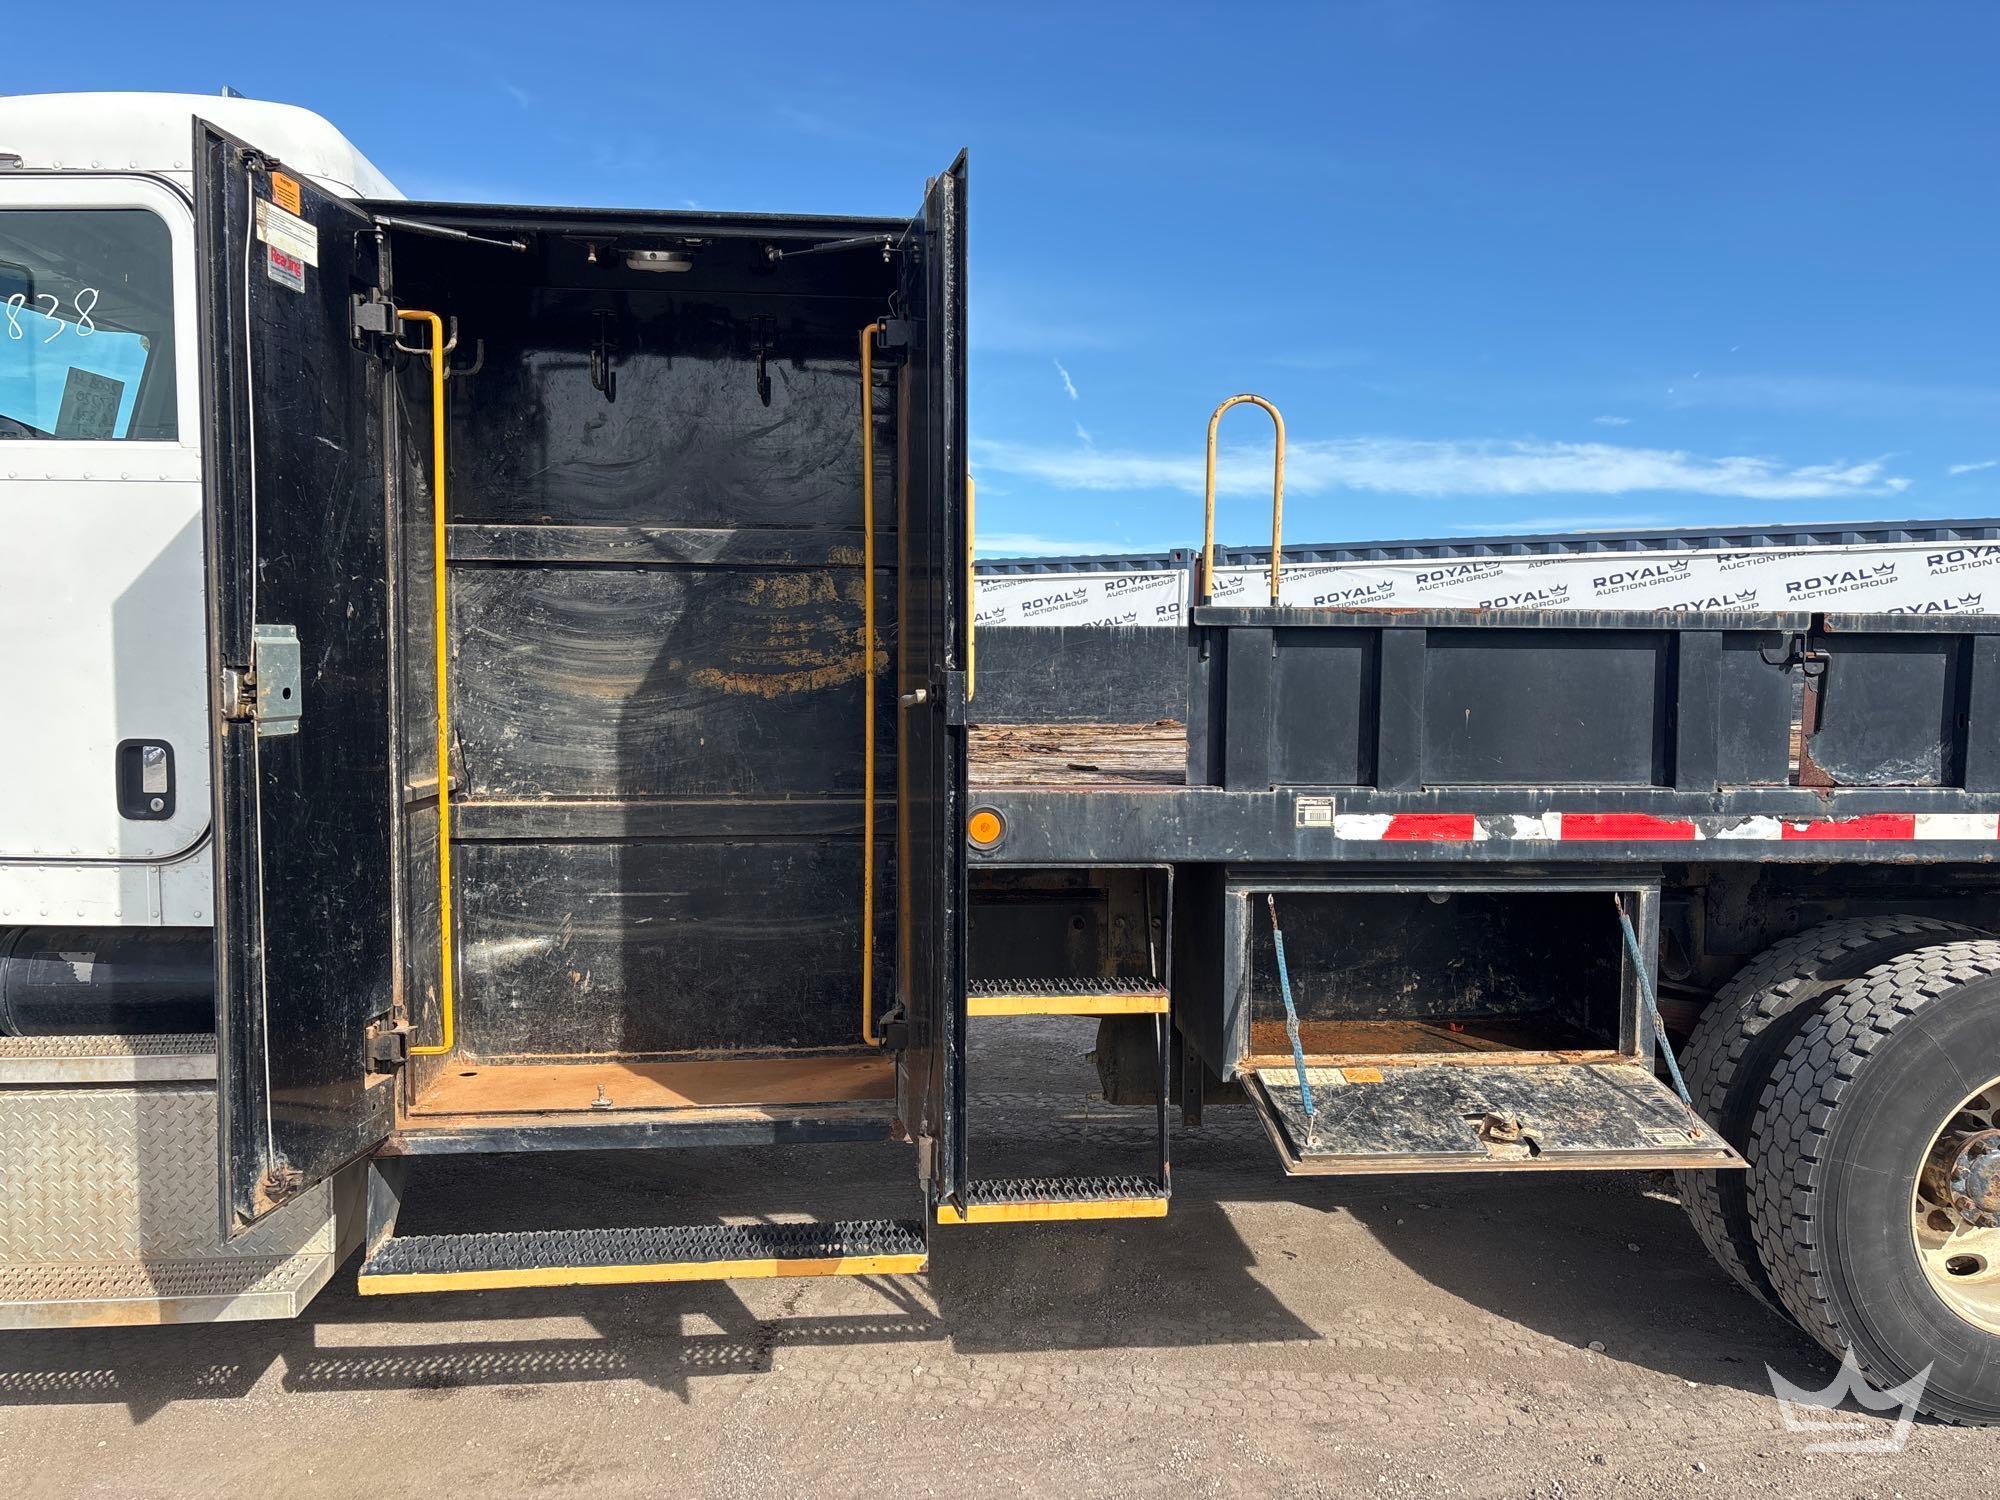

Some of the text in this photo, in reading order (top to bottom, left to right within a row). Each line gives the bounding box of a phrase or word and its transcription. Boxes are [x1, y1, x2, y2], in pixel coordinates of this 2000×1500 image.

[6, 288, 100, 344] 838
[1719, 554, 1776, 571] AUCTION
[1927, 546, 2000, 567] ROYA
[1416, 562, 1484, 584] ROYAL
[1930, 558, 1993, 576] AUCTION
[1265, 572, 1307, 587] ACTION
[1418, 569, 1504, 592] AUCTION GROUP
[1593, 565, 1669, 589] ROYAL
[1595, 572, 1692, 597] AUCTION GROUP
[1785, 569, 1873, 594] ROYAL
[982, 581, 1016, 593] AUCTION
[1107, 577, 1176, 598] AUCTION GROUP
[1213, 587, 1245, 599] GROUP
[1313, 585, 1377, 606] ROYAL
[1789, 576, 1899, 602] AUCTION GROUP
[1022, 592, 1073, 611] ROYAL
[1361, 592, 1396, 604] GROUP
[1479, 590, 1549, 609] ROYAL
[1531, 597, 1570, 610] GROUP
[1656, 595, 1736, 611] OYAL
[1024, 598, 1089, 618] AUCTION GROUP
[1157, 613, 1180, 623] AUCT
